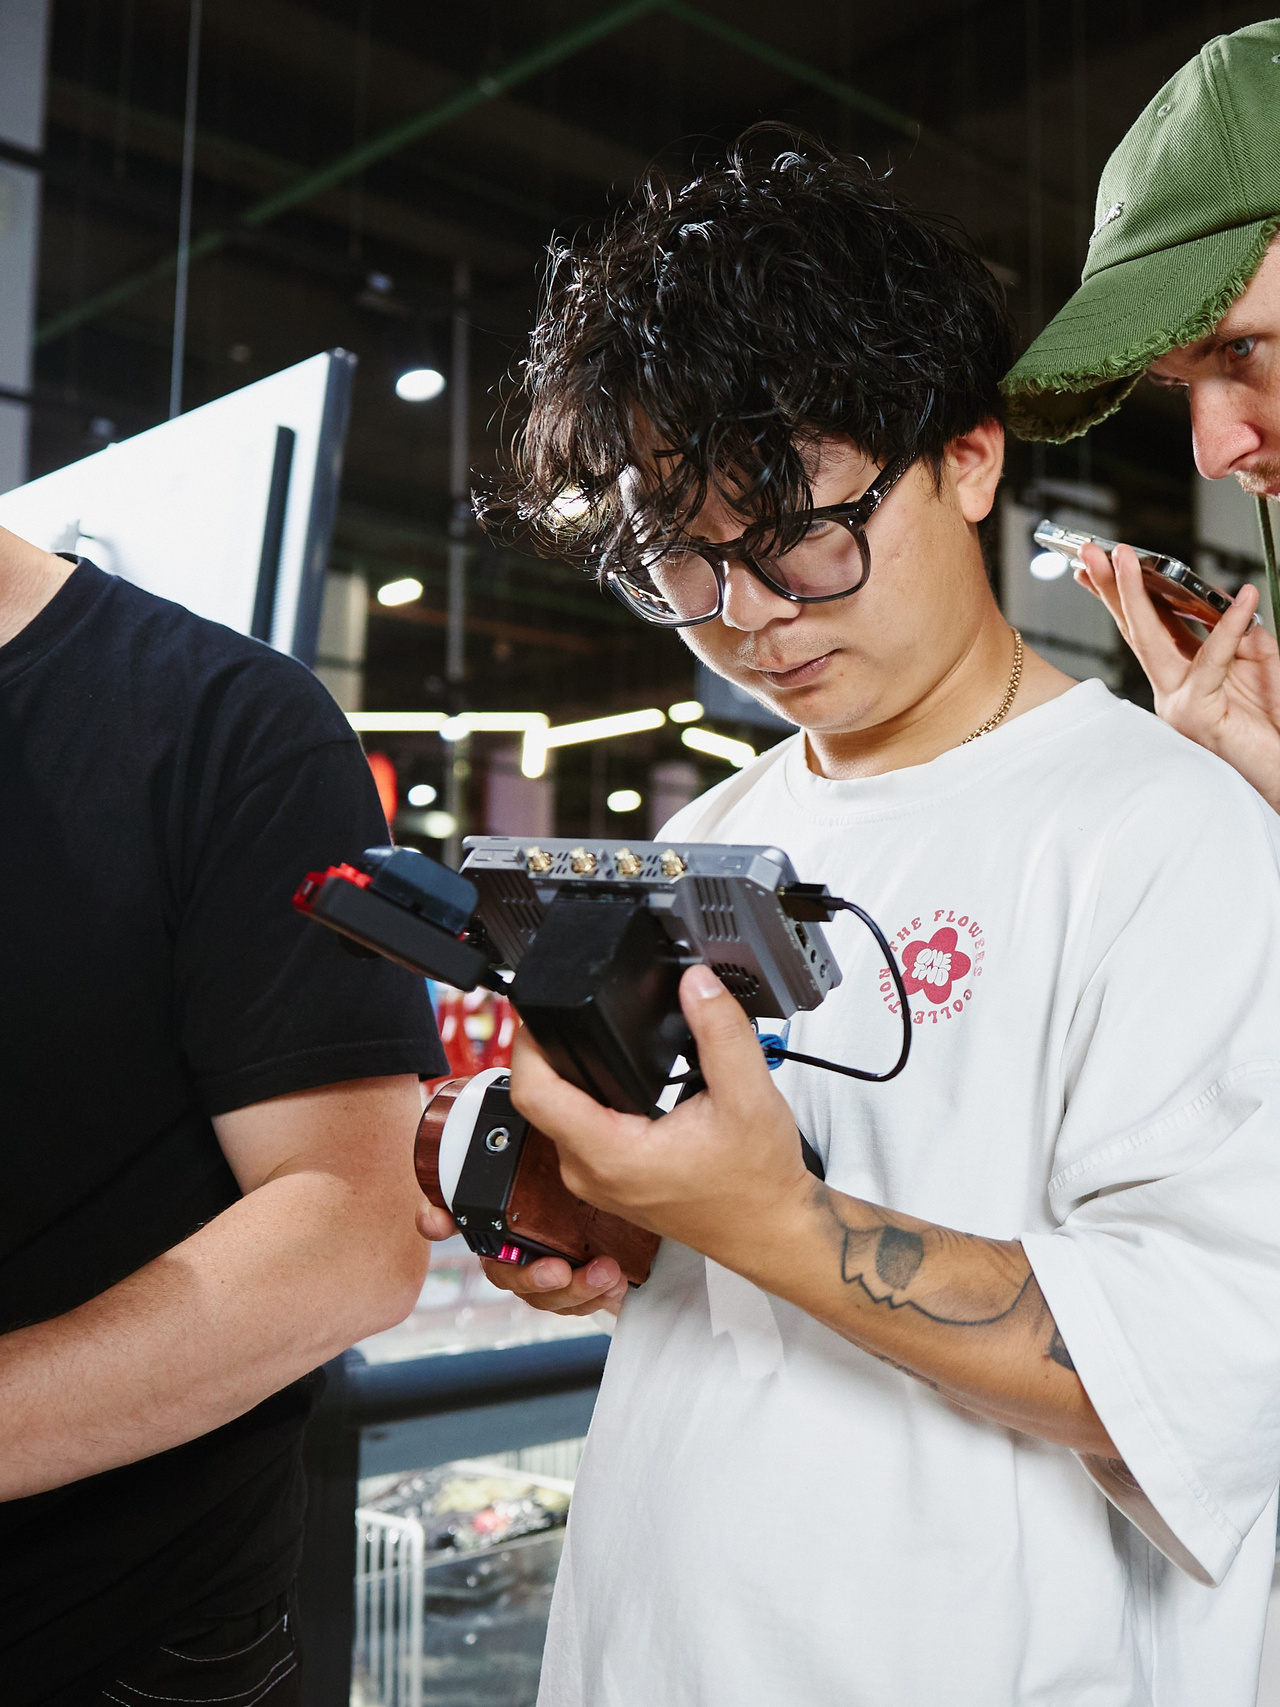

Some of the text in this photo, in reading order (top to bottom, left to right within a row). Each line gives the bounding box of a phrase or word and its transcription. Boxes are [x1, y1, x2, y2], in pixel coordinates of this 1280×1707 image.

[888, 909, 986, 977] THE FLOWERS
[916, 948, 952, 971] ONE
[878, 968, 973, 1025] COLLETION
